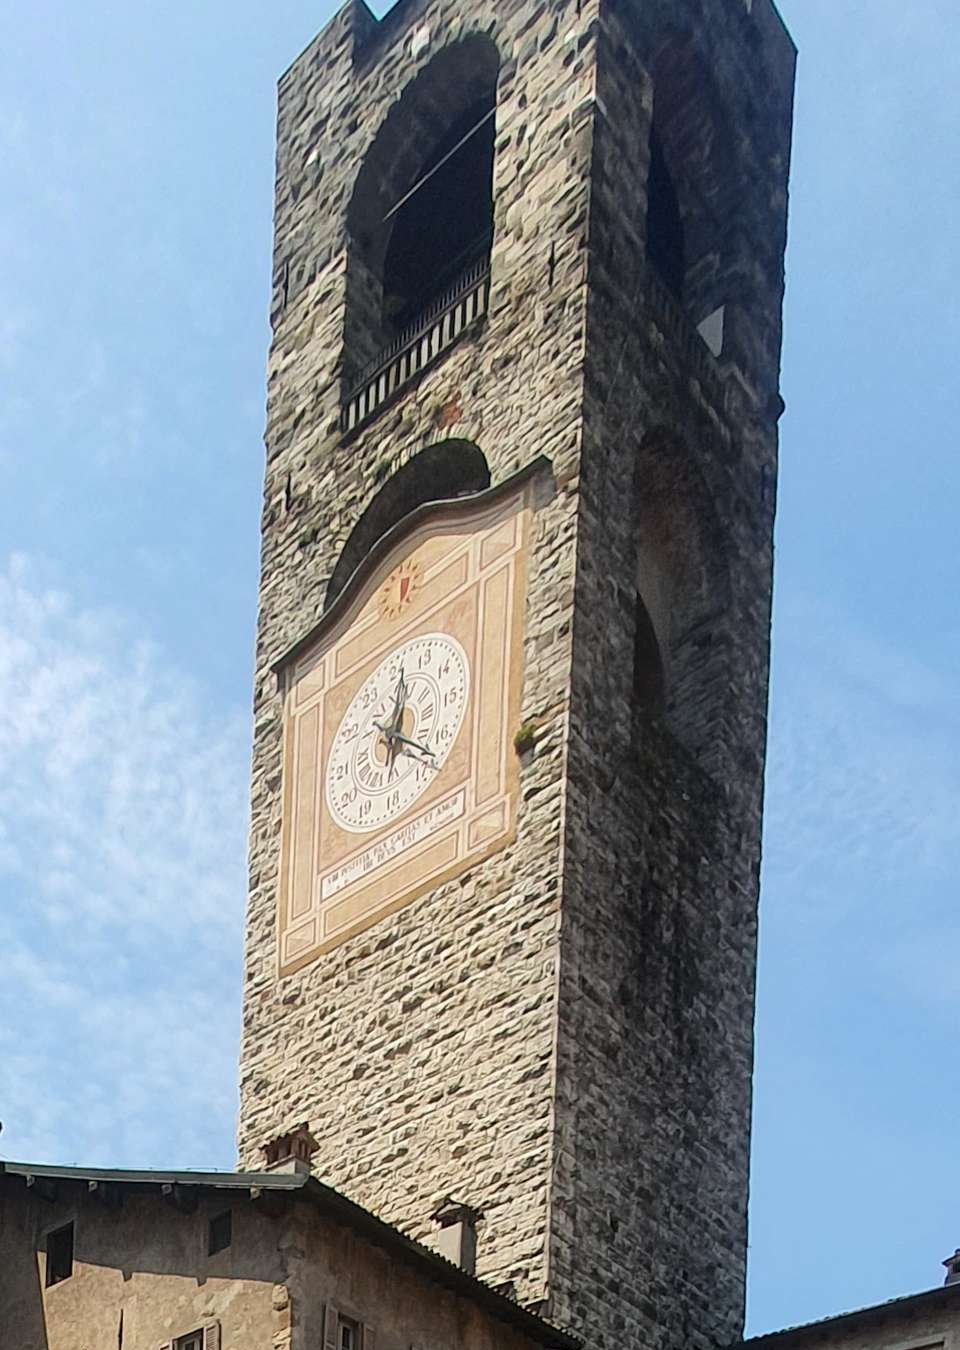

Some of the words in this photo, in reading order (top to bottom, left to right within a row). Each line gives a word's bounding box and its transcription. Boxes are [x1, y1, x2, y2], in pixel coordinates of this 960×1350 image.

[418, 648, 431, 670] 13
[438, 658, 450, 680] 14
[388, 659, 405, 682] 24
[363, 687, 378, 710] 23
[444, 687, 457, 708] 15
[341, 723, 359, 745] 22
[435, 724, 449, 745] 16
[336, 762, 348, 781] 21
[416, 760, 429, 781] 17
[341, 787, 357, 808] 20
[386, 790, 399, 811] 18
[359, 799, 371, 819] 19
